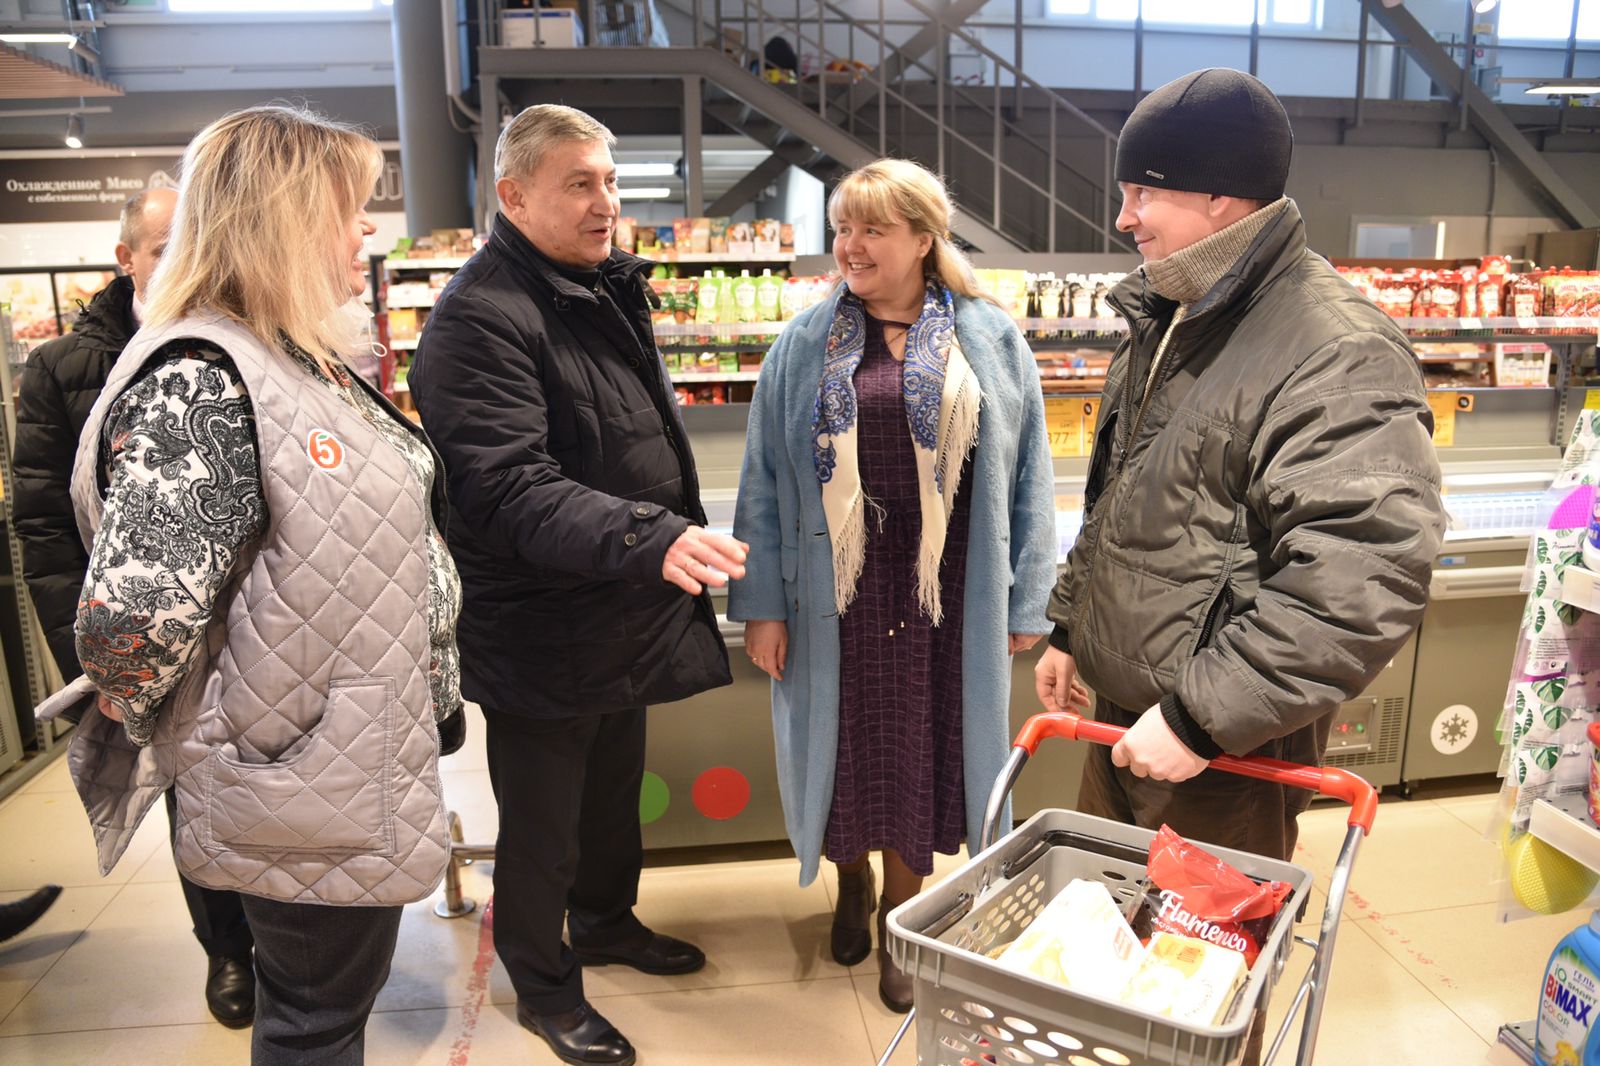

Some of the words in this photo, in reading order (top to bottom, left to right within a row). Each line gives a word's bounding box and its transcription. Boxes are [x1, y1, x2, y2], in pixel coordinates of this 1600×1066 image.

[6, 179, 101, 192] Охлажденное
[106, 177, 144, 189] Мясо
[1159, 889, 1247, 952] Flamenco
[1543, 1000, 1570, 1027] COLOR
[1545, 974, 1592, 1027] BiMAX
